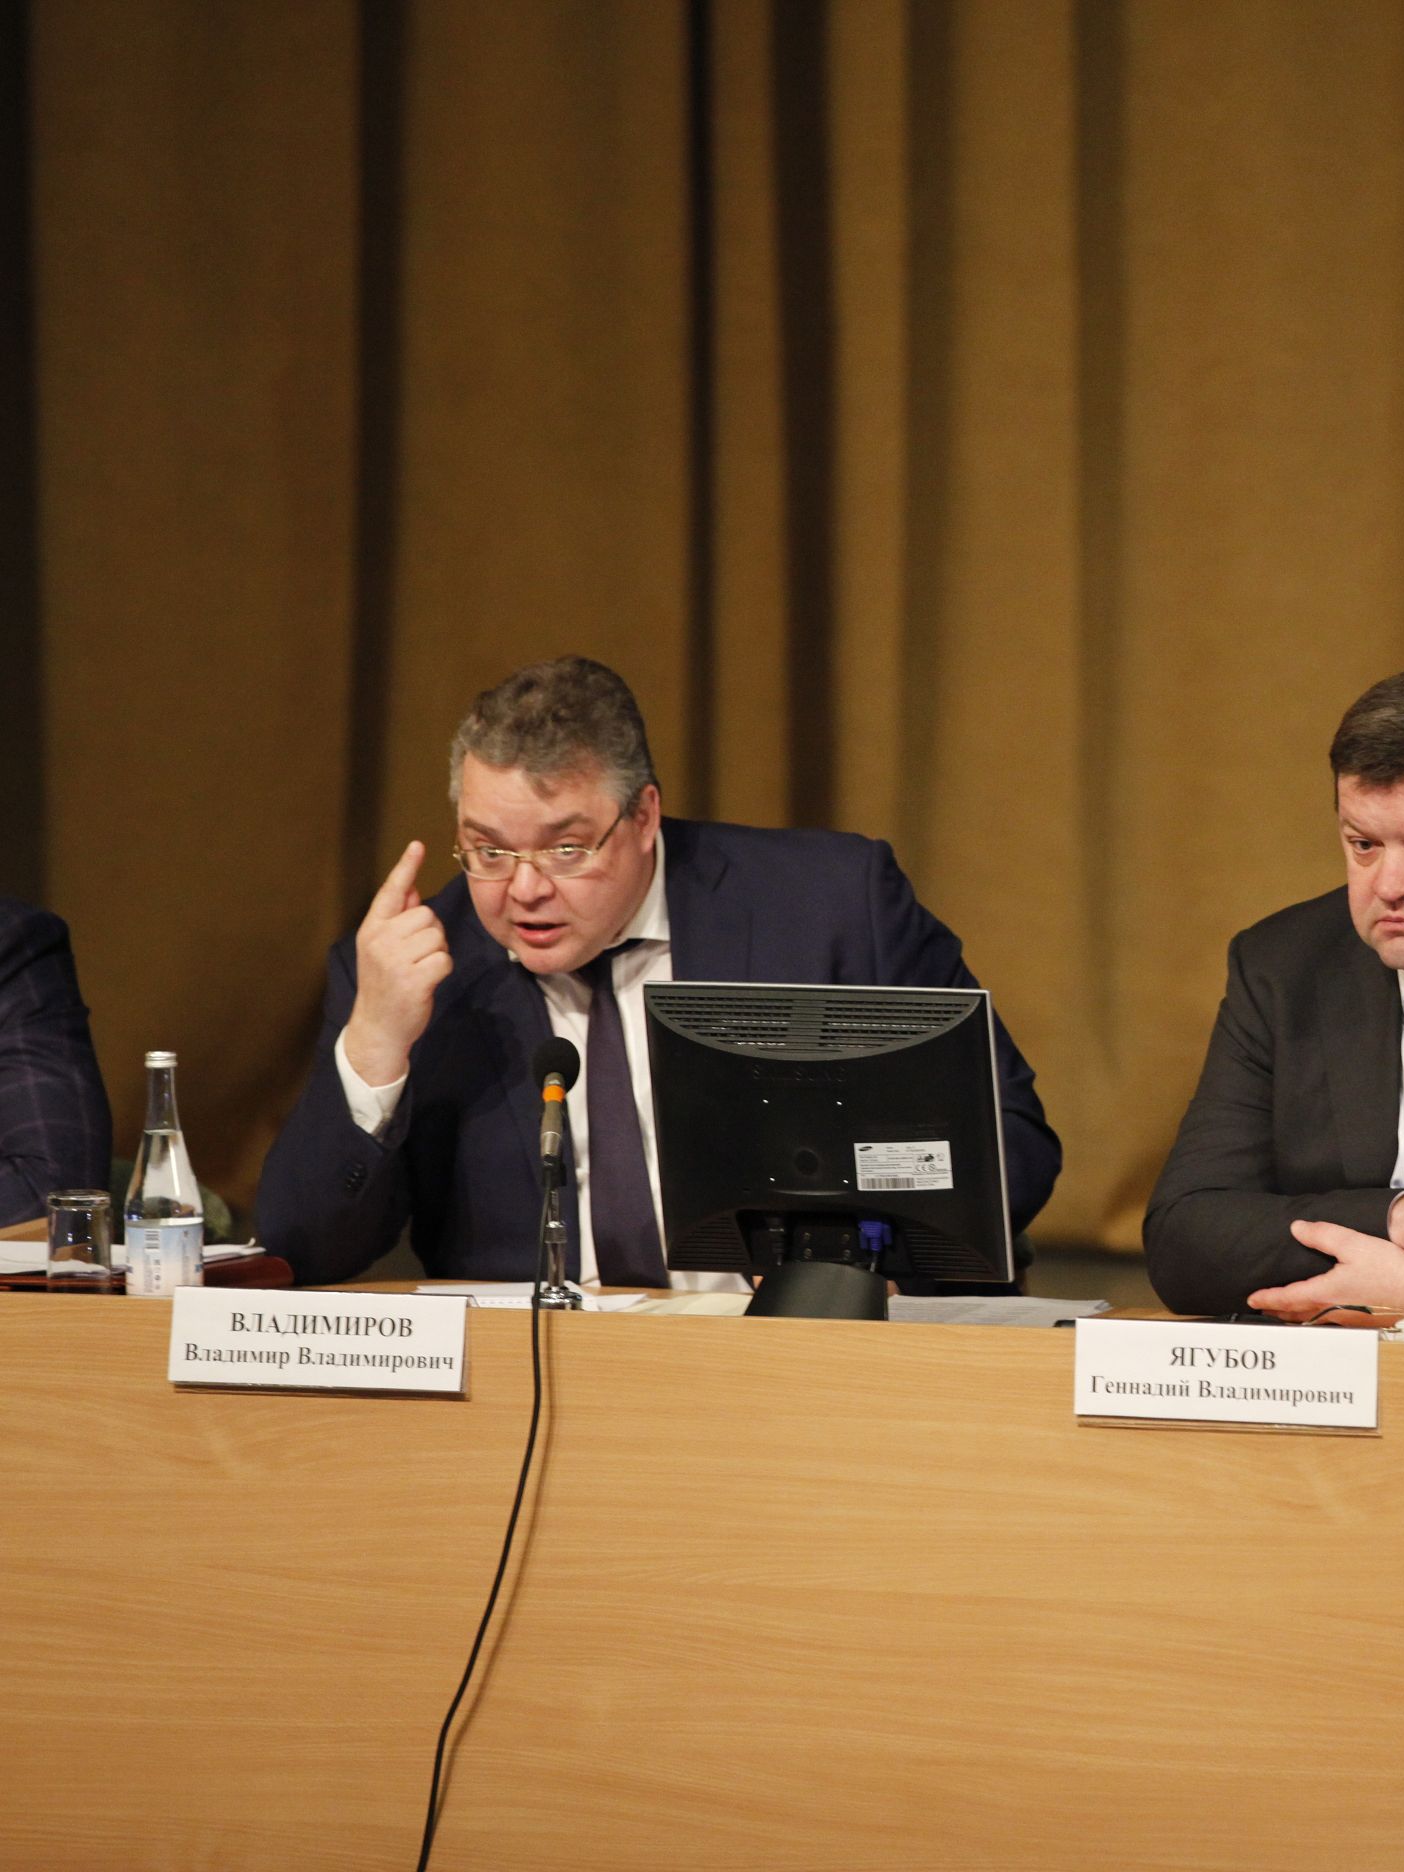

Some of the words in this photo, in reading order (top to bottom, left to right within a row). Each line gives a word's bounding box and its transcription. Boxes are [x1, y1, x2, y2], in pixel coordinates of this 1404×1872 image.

[230, 1311, 413, 1338] ВЛАДИМИРОВ
[184, 1342, 291, 1369] Владимир
[298, 1346, 454, 1373] Владимирович
[1169, 1346, 1277, 1370] ЯГУБОВ
[1091, 1375, 1190, 1398] Геннадий
[1199, 1380, 1355, 1407] Владимирович
